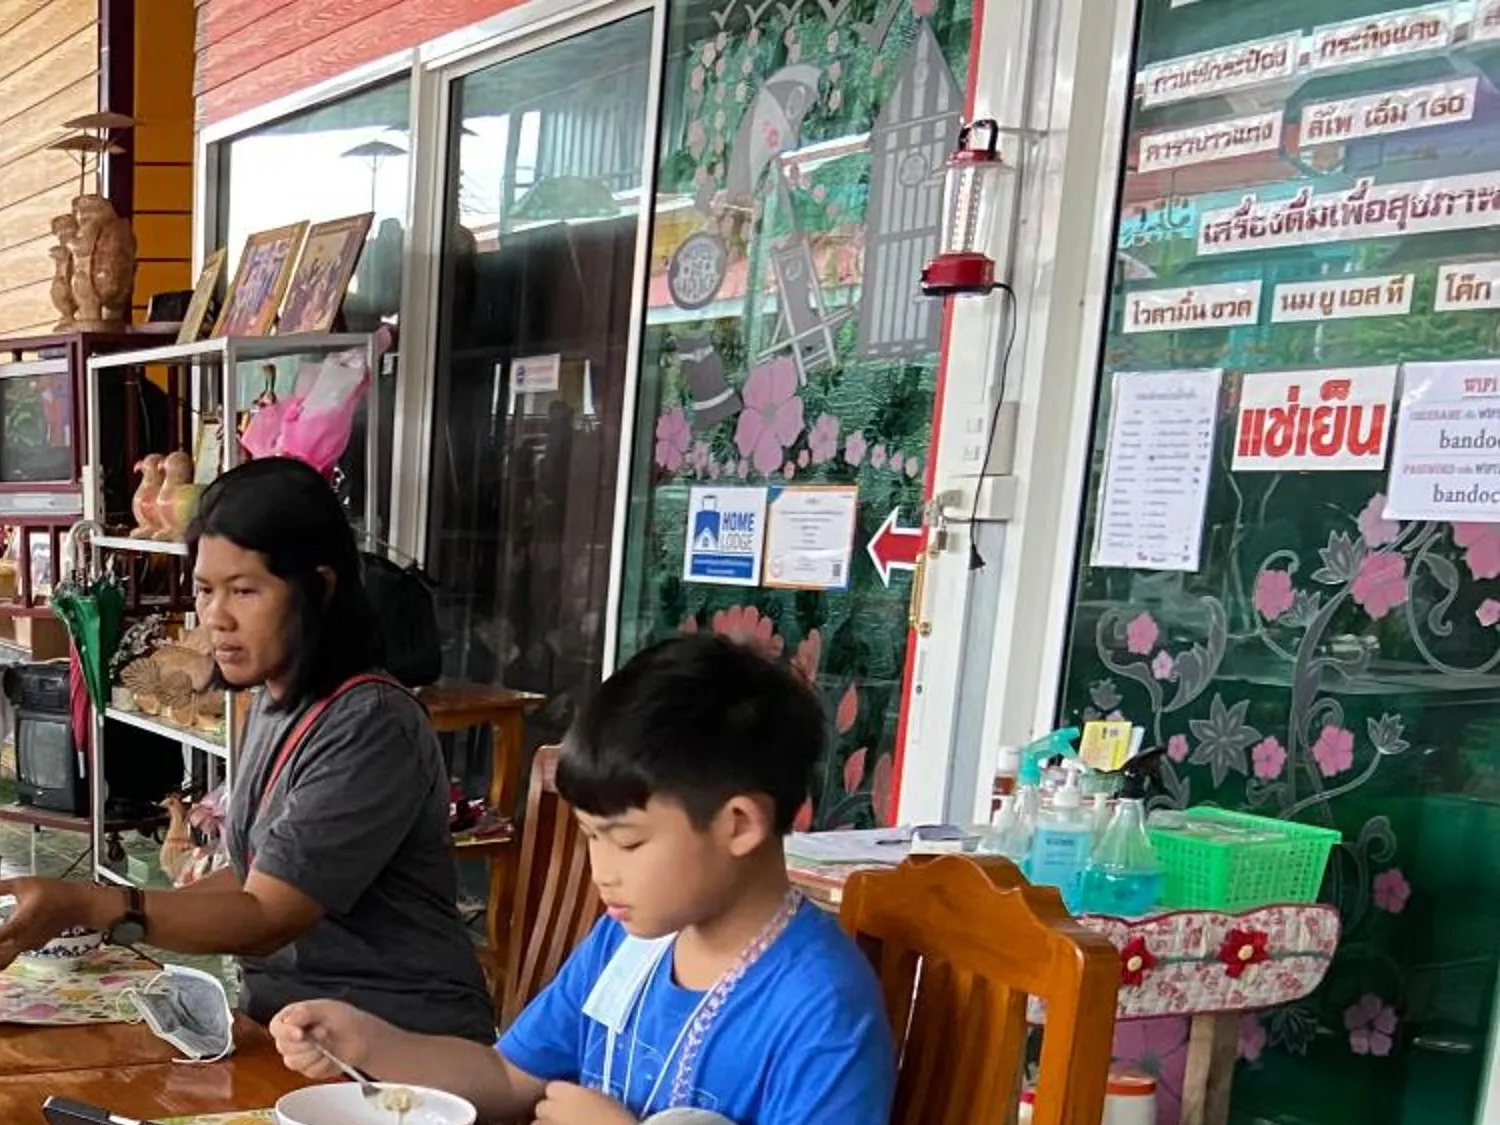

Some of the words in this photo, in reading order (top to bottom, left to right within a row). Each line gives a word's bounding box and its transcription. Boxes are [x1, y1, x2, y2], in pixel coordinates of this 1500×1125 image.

[1320, 20, 1441, 61] กระทิงแดง
[1145, 122, 1274, 161] คาราบาวแดง
[1237, 379, 1386, 457] แช่เย็น
[722, 511, 755, 531] HOME
